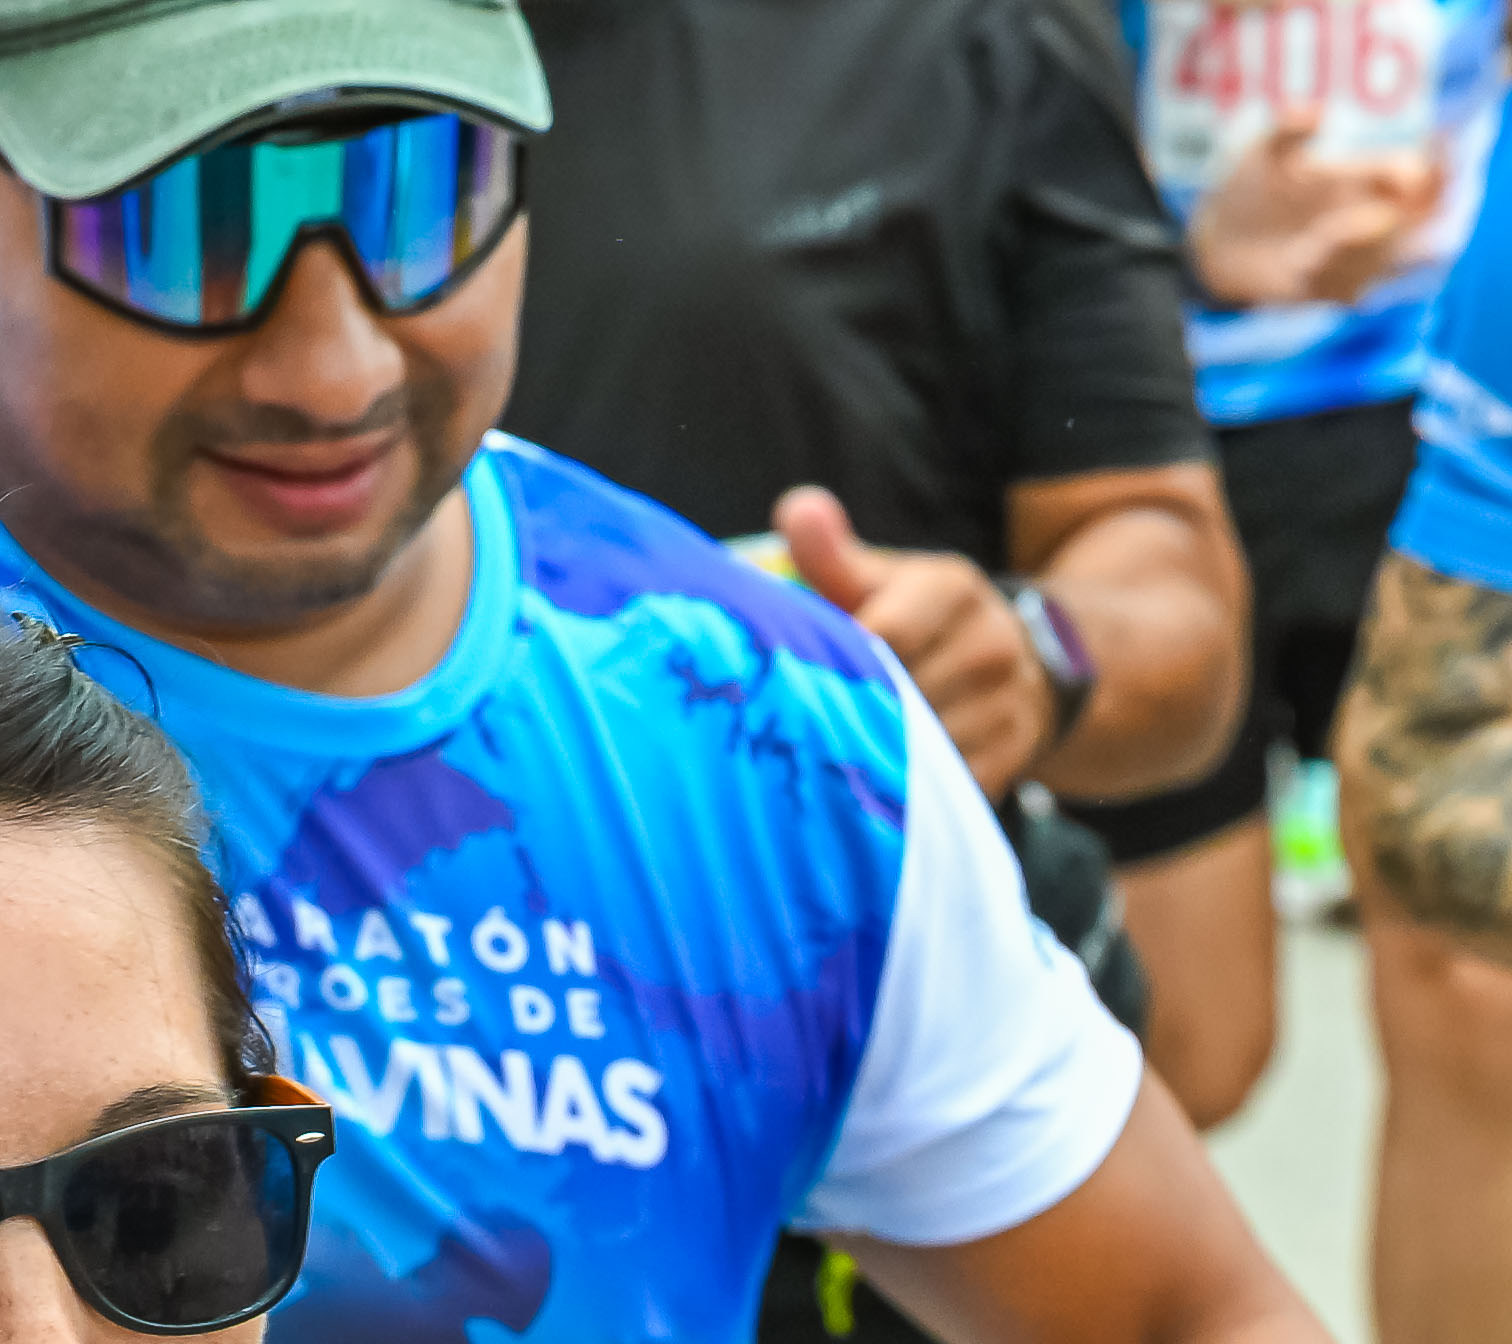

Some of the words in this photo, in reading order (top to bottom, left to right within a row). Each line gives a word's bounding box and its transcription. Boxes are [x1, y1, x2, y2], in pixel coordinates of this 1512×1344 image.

[1176, 0, 1422, 113] 406
[255, 958, 472, 1027] ROES
[510, 983, 607, 1040] DE
